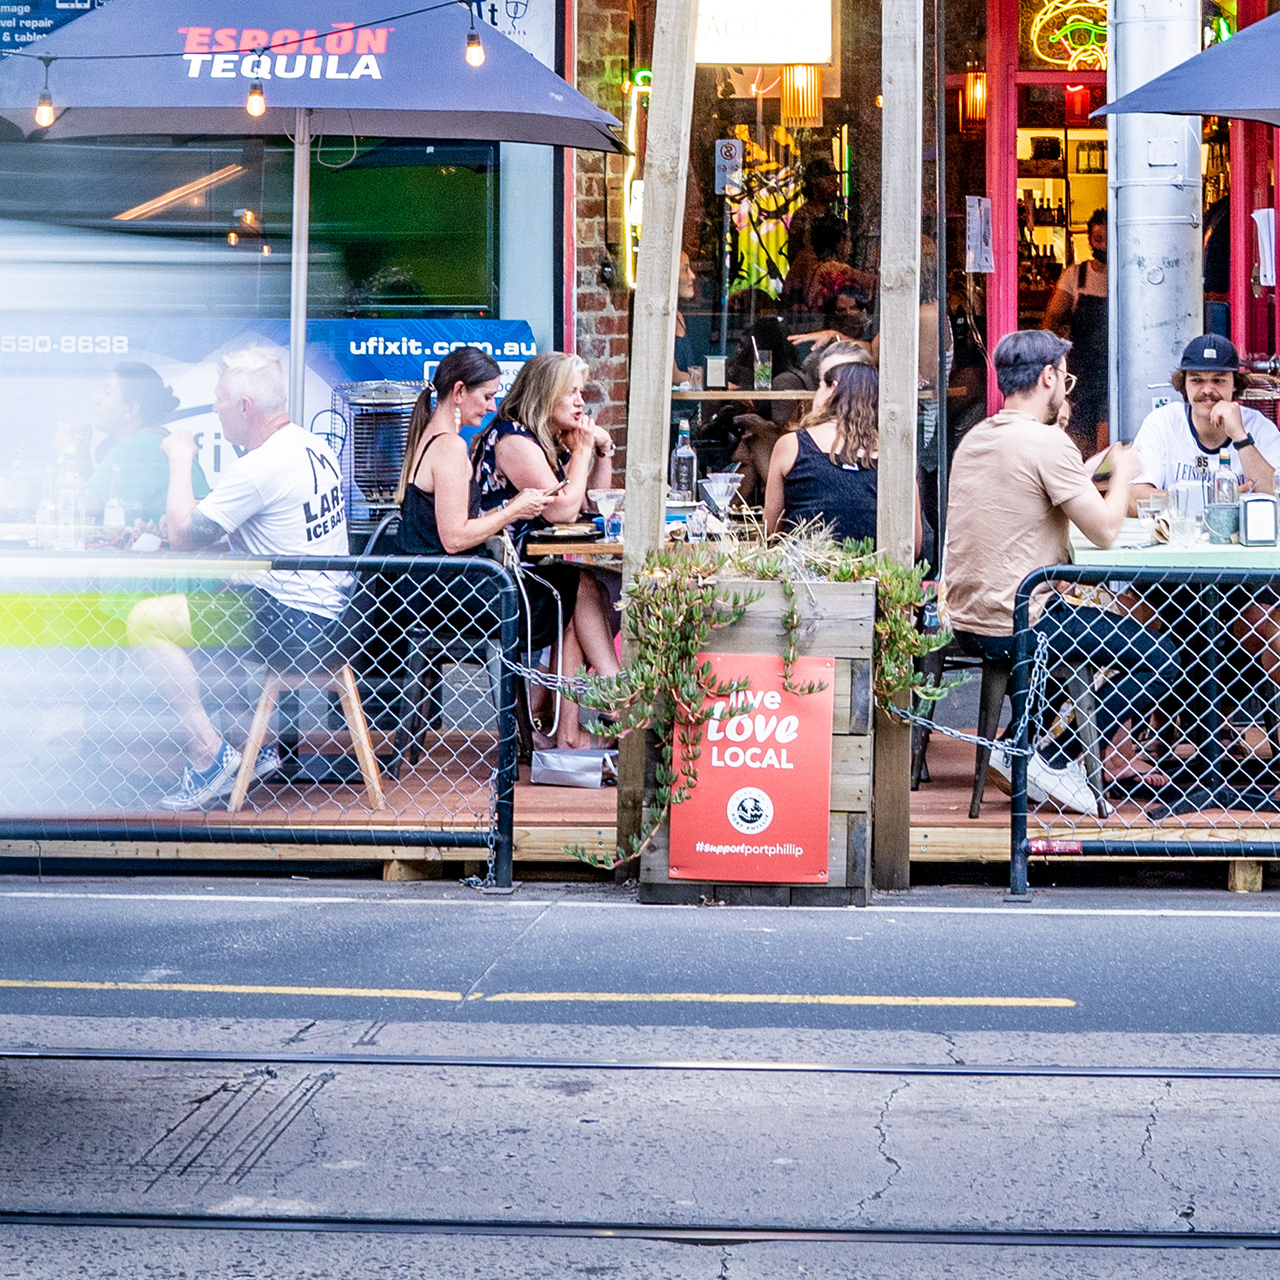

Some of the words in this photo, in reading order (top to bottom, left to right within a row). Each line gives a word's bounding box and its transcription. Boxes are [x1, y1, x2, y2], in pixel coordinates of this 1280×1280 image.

[19, 18, 54, 31] repair
[2, 32, 11, 43] &
[182, 53, 383, 80] TEQUILA
[1196, 456, 1209, 468] 85
[306, 520, 330, 542] ICE
[711, 746, 794, 770] LOCAL
[695, 841, 804, 858] #supportportphillip
